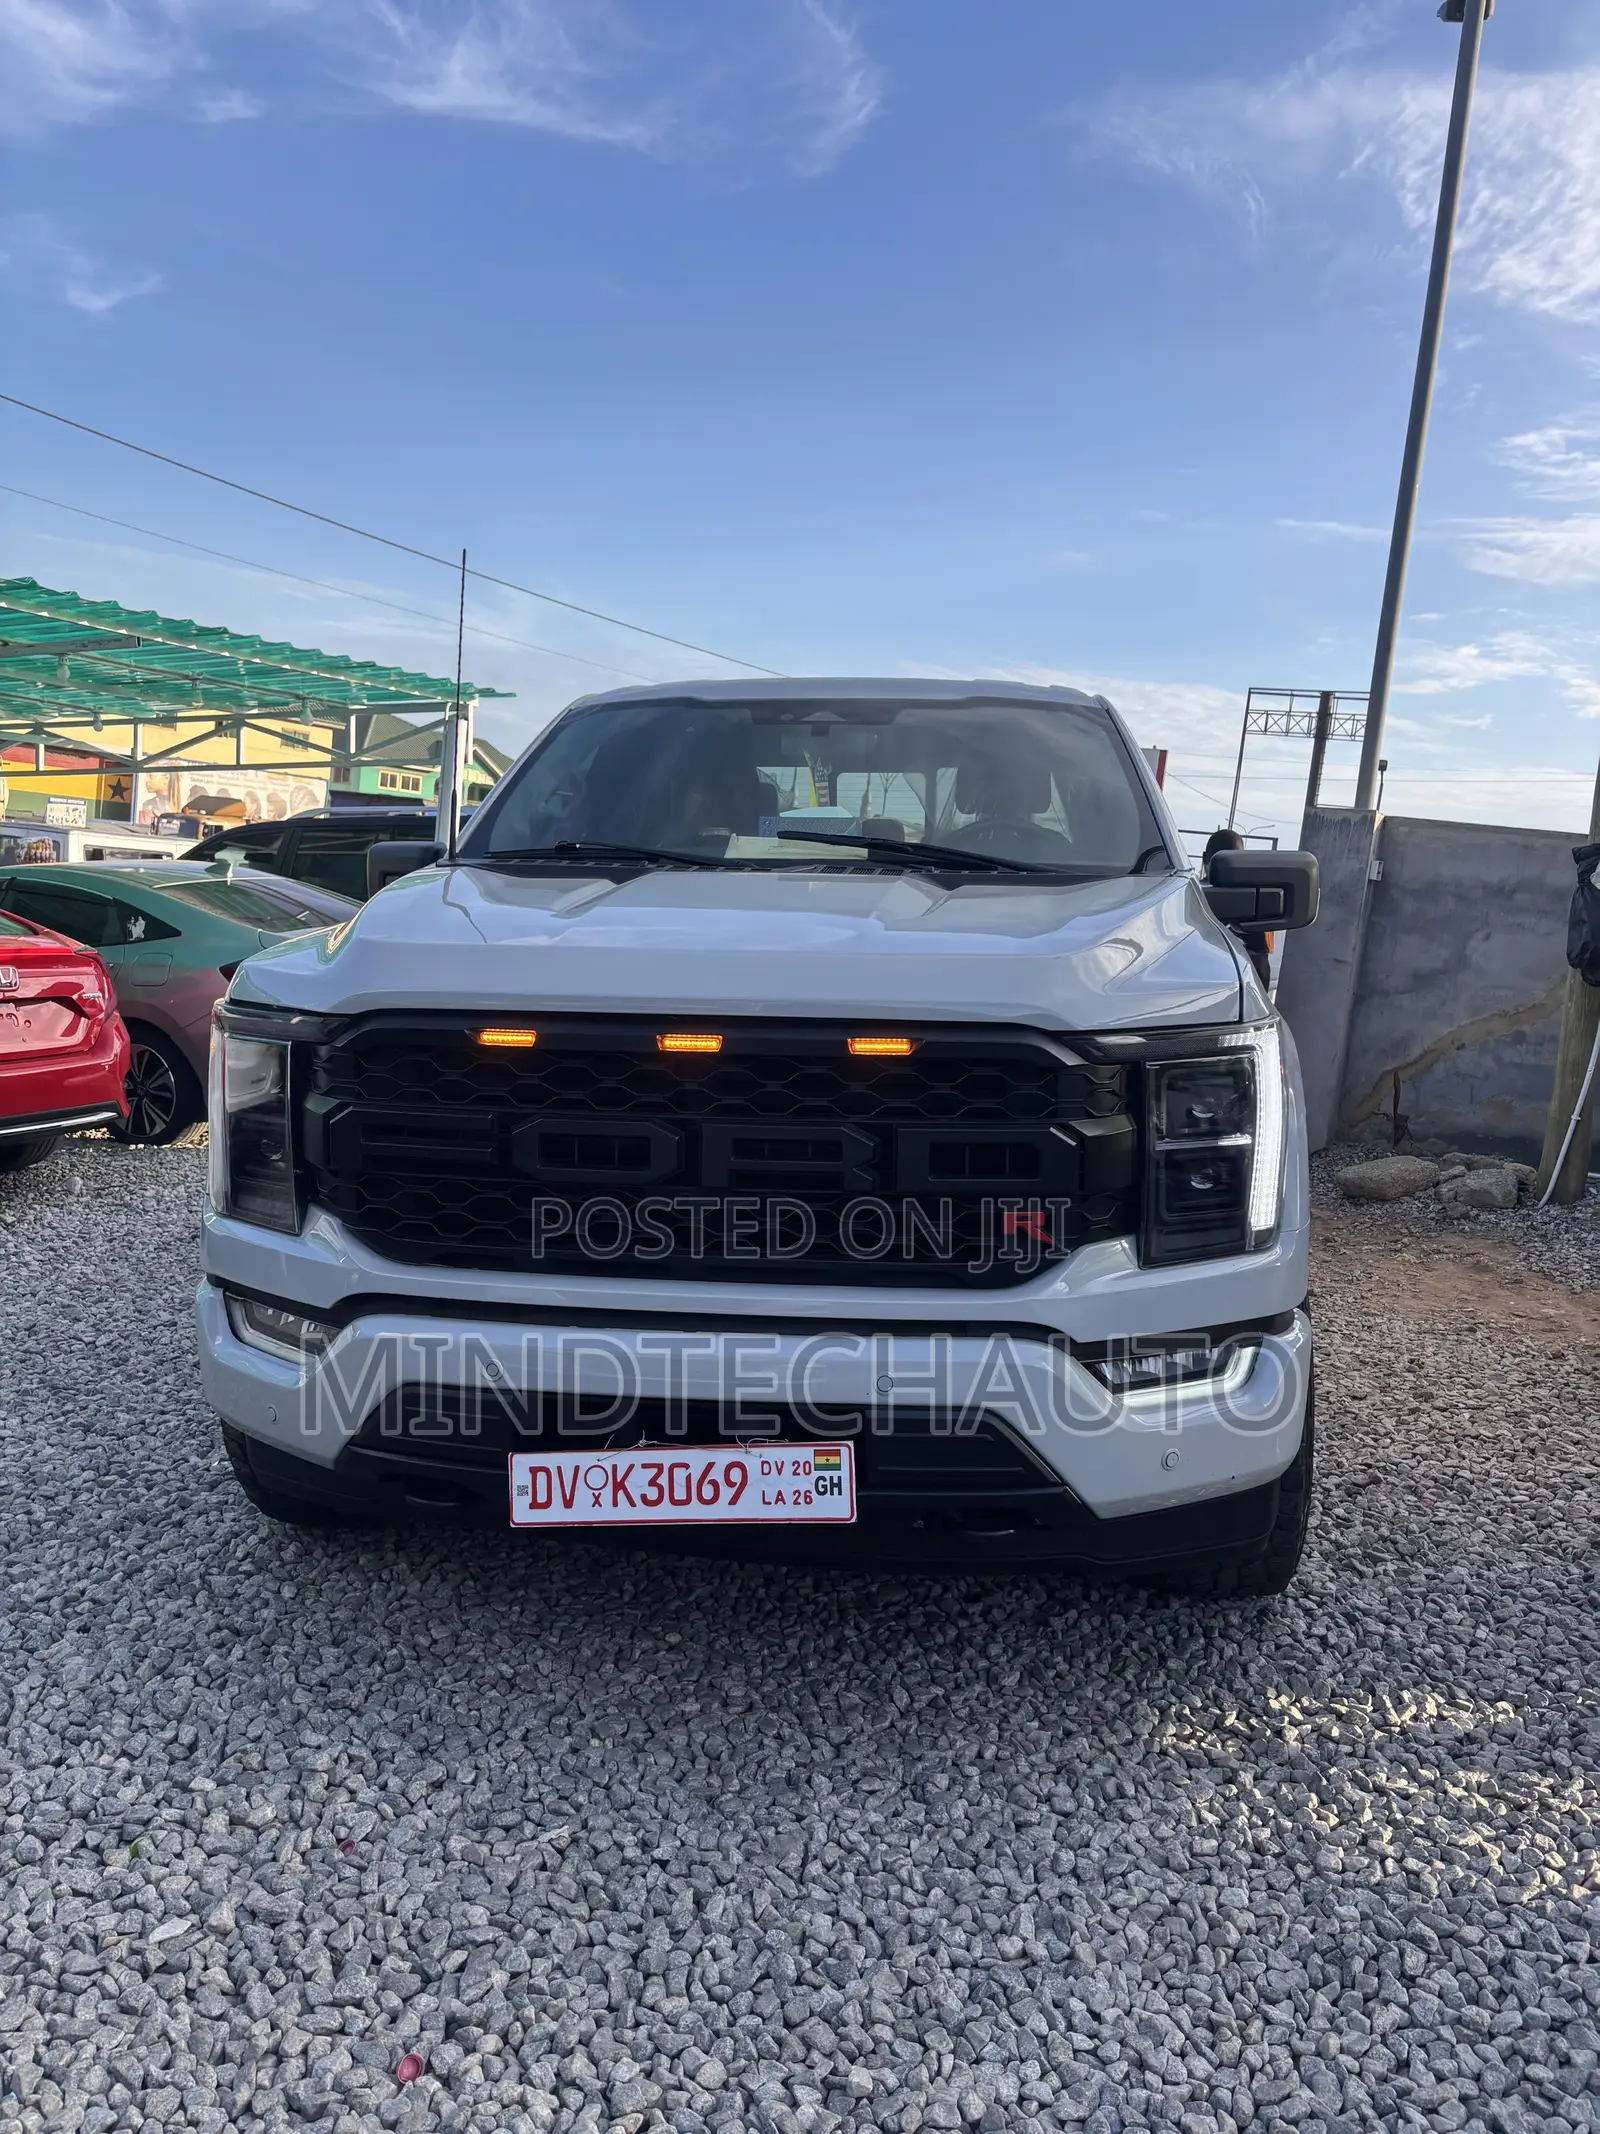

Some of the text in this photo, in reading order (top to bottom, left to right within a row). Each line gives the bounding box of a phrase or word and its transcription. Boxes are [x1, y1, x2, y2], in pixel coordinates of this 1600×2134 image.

[760, 1459, 812, 1477] DV 20
[814, 1475, 843, 1497] GH
[761, 1489, 814, 1506] LA 26
